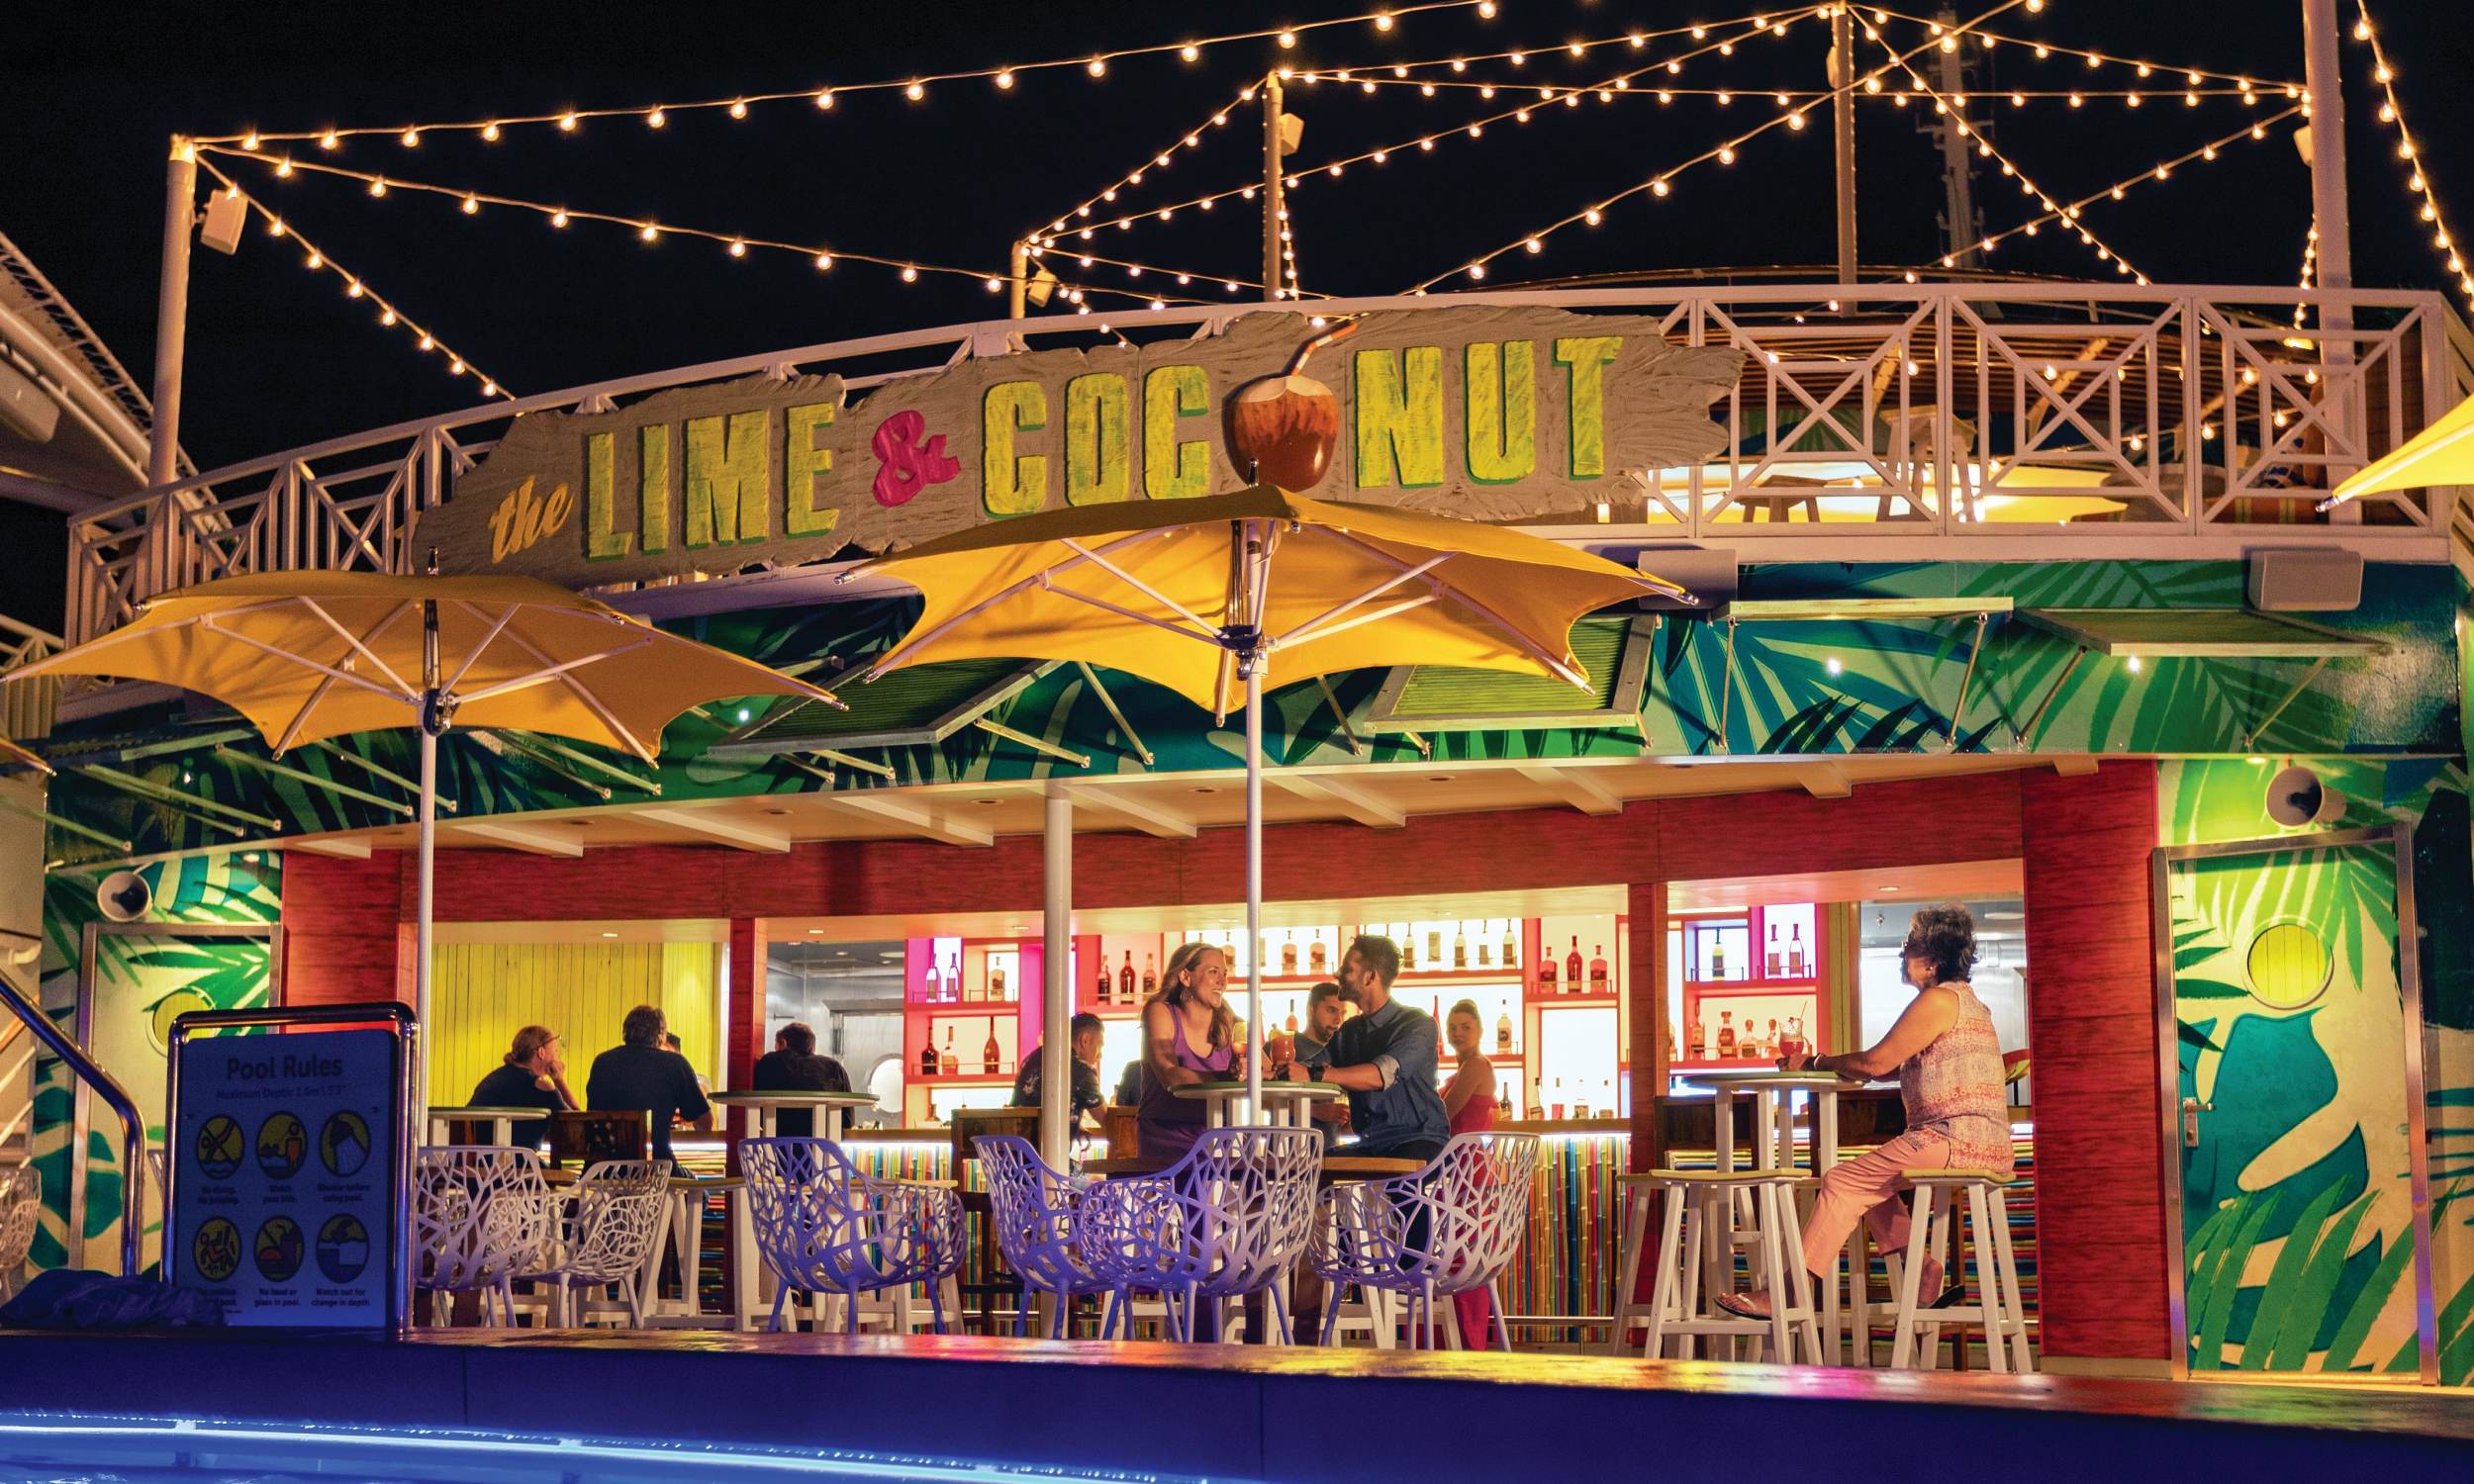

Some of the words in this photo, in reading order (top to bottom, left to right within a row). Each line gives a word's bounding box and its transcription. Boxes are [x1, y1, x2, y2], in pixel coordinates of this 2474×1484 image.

[489, 475, 574, 564] the
[585, 402, 841, 562] LIME
[871, 409, 961, 508] &
[227, 1057, 276, 1081] Pool
[283, 1053, 343, 1077] Rules
[354, 1287, 366, 1296] for
[311, 1298, 337, 1308] change
